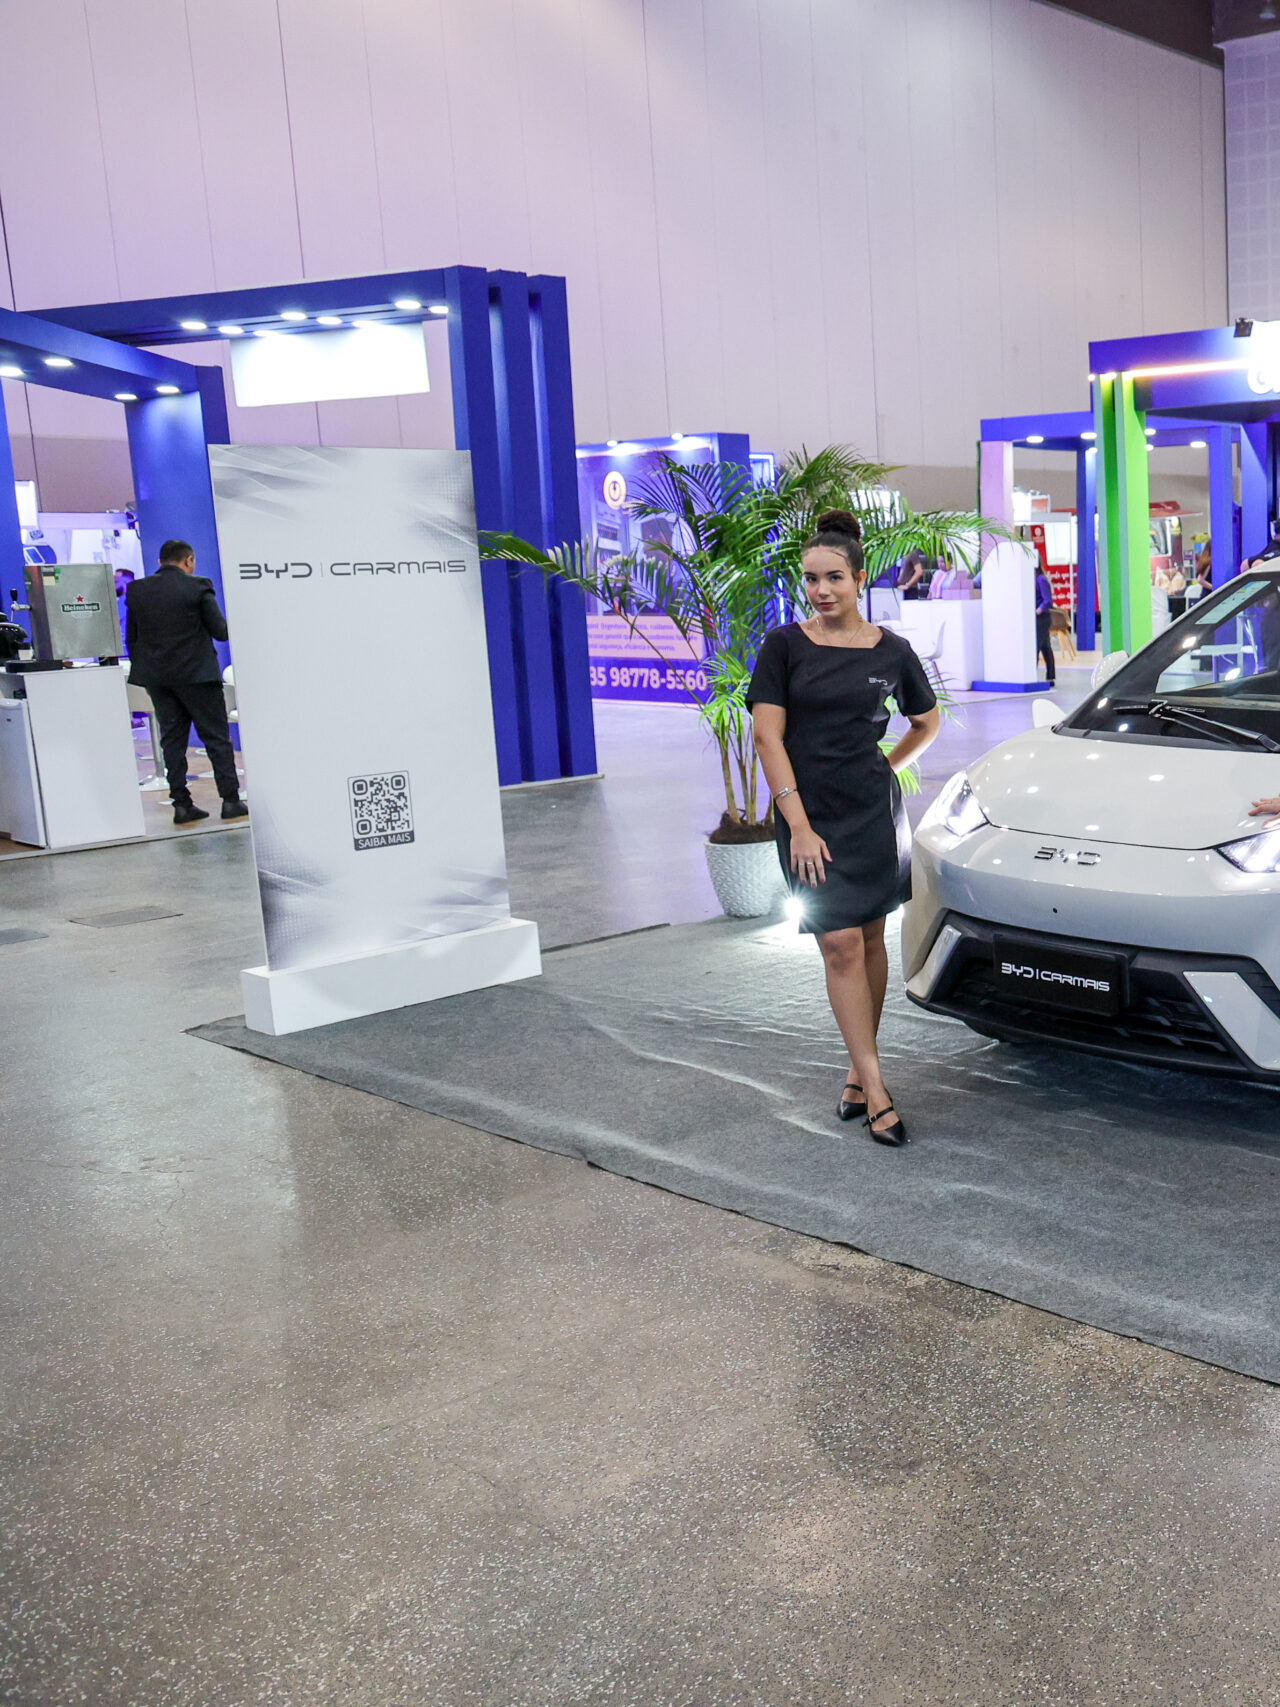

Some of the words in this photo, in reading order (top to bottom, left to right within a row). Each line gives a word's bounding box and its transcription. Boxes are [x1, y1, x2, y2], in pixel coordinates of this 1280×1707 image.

[239, 562, 313, 580] BYD
[330, 560, 467, 576] CARMAIS
[64, 603, 98, 611] Heineken
[609, 667, 708, 691] 98778-5560
[358, 837, 387, 849] SAIBA
[388, 832, 411, 844] MAIS
[1001, 962, 1034, 979] BYD
[1040, 971, 1111, 992] CARMAIS
